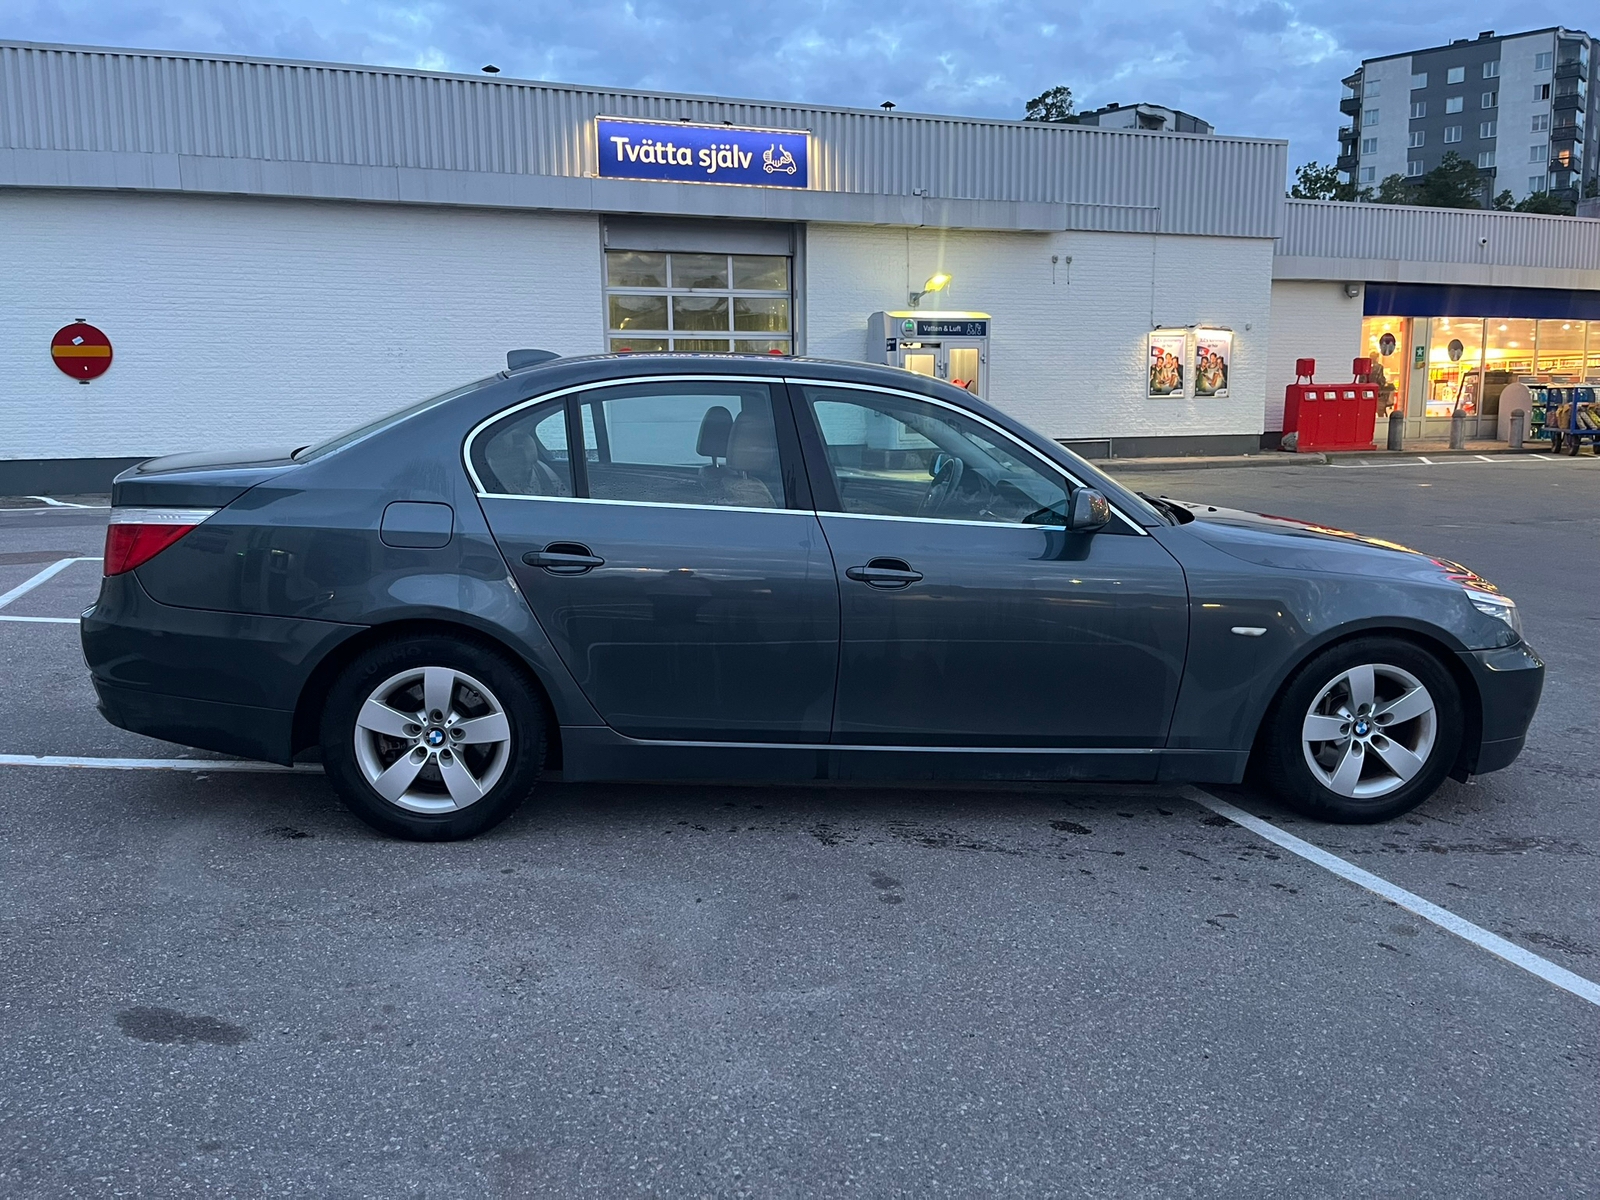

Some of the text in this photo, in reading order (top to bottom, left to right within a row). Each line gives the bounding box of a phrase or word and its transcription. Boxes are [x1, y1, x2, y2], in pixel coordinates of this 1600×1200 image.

[610, 137, 753, 174] Tvätta själv
[922, 324, 943, 332] Vatten
